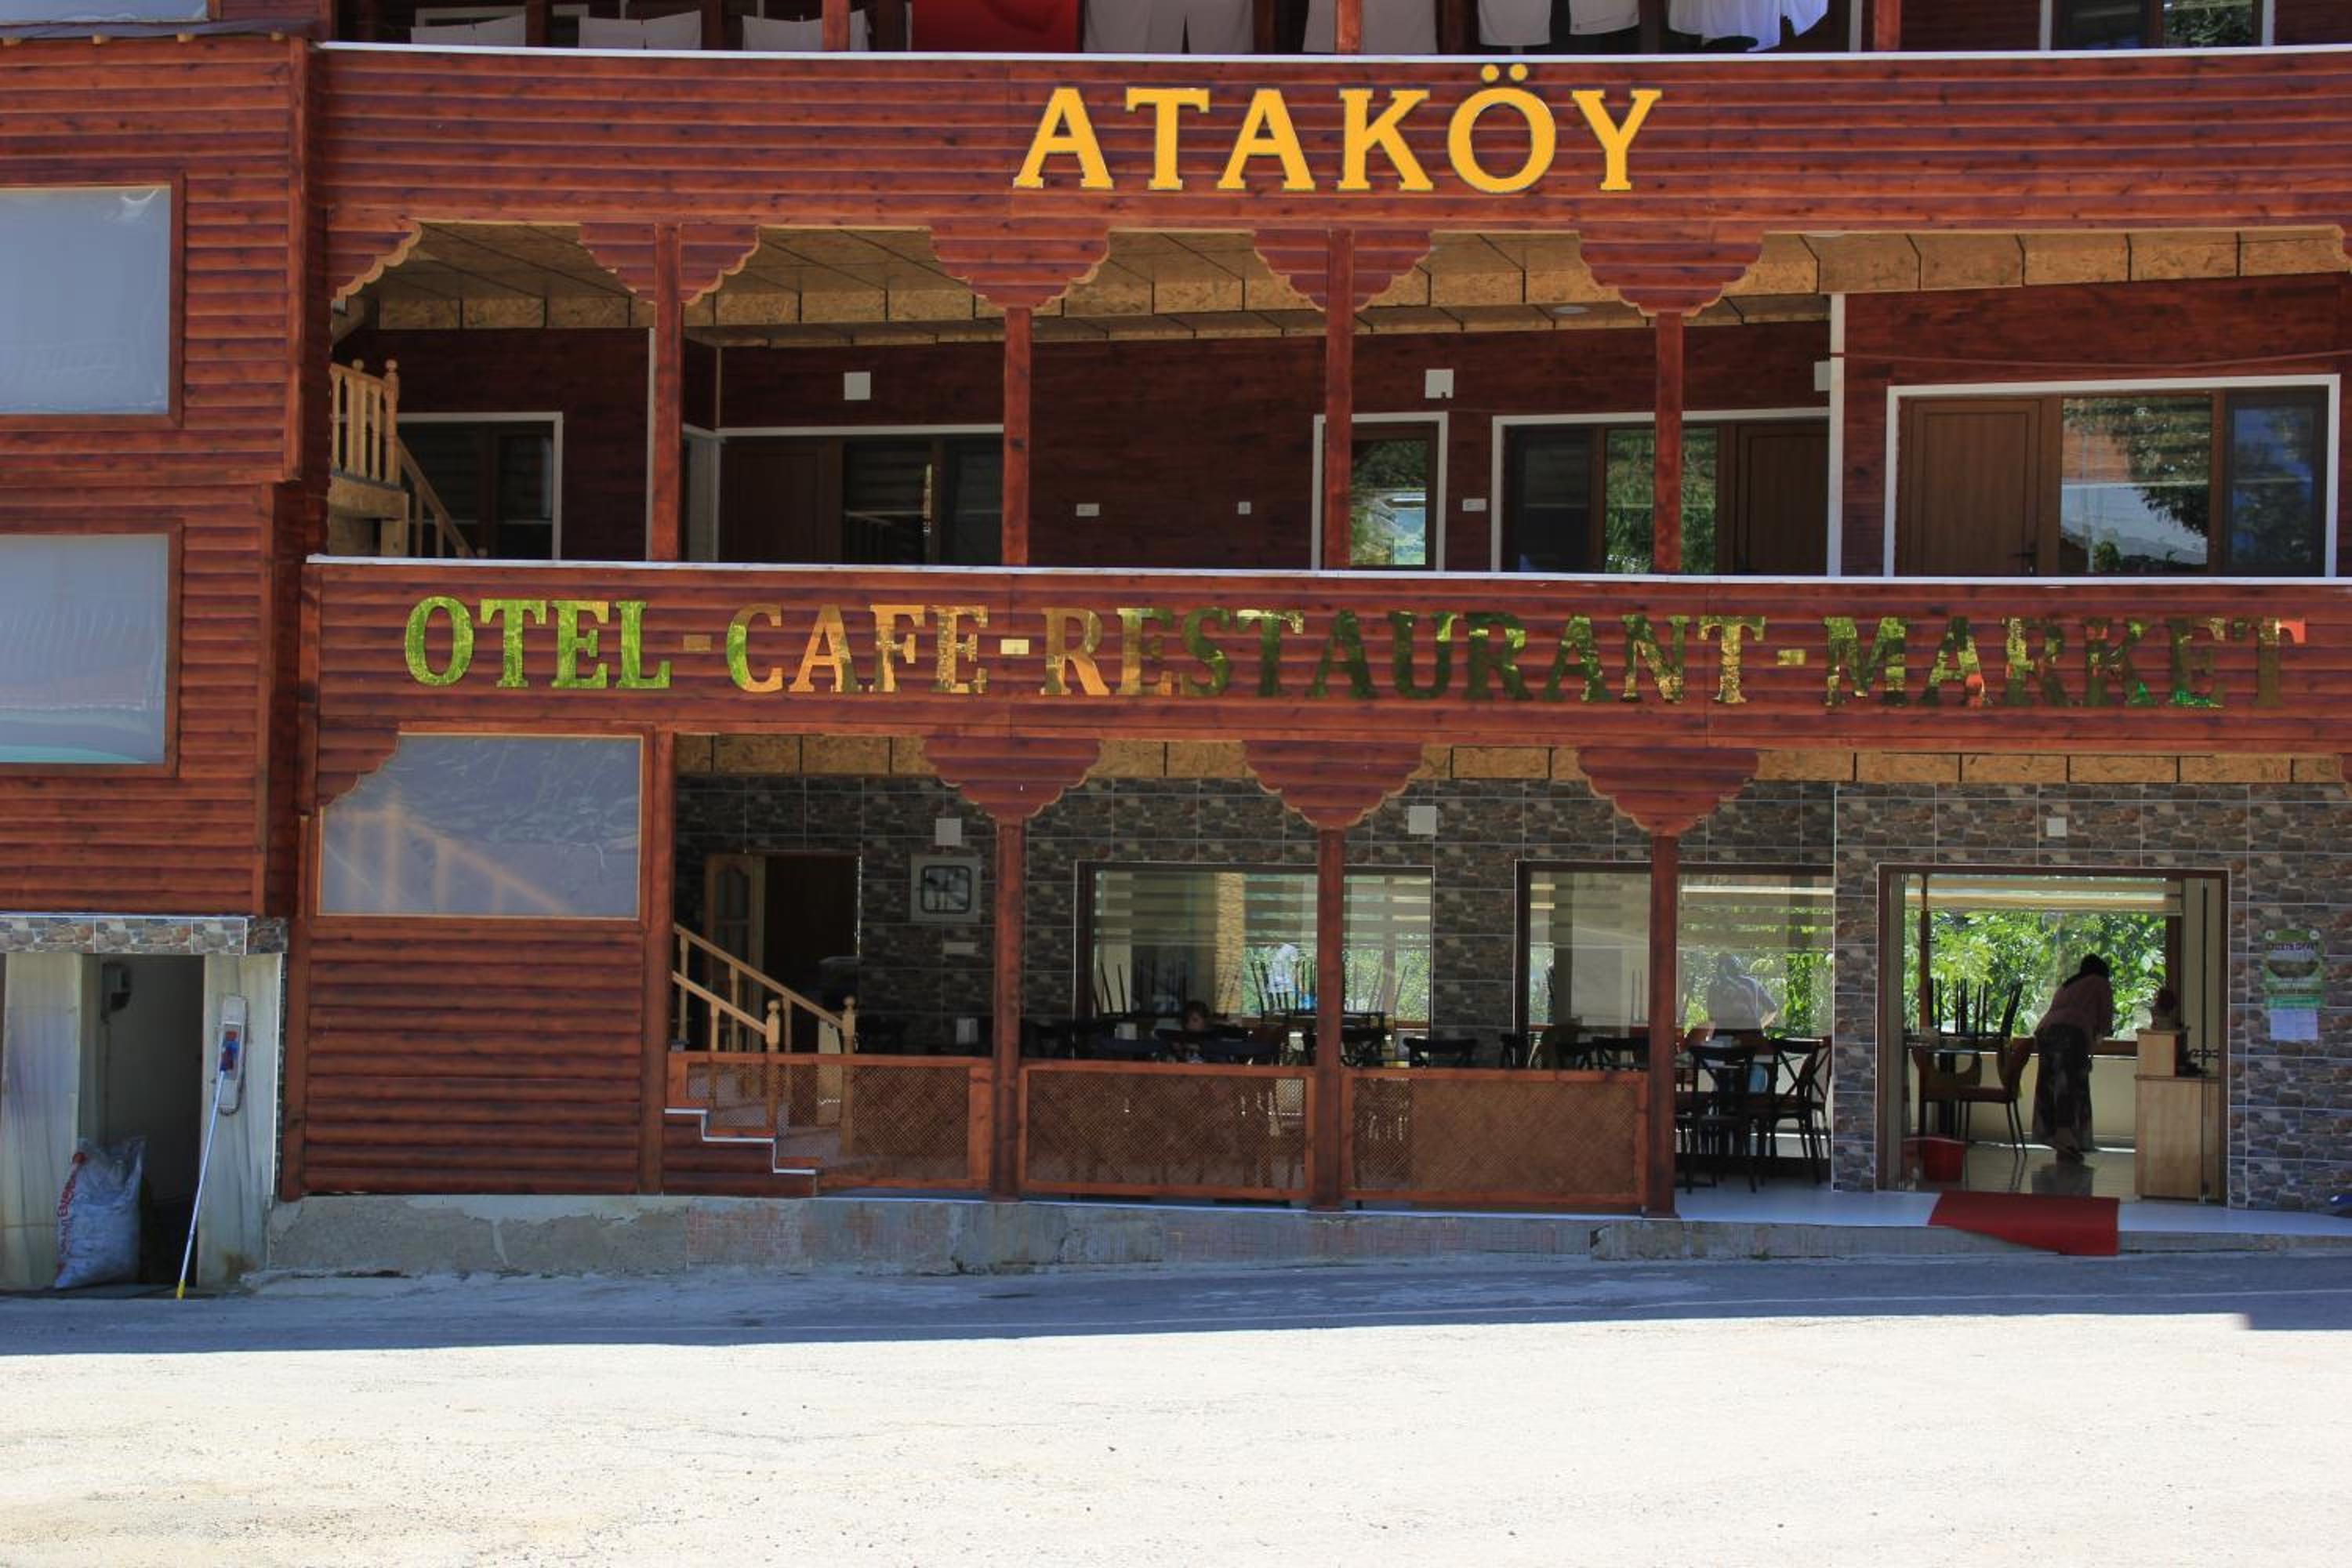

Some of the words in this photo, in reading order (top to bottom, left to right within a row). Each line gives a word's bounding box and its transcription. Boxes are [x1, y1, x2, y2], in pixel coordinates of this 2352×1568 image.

[1012, 64, 1663, 194] ATAKÖY
[405, 596, 671, 688] OTEL
[725, 604, 989, 694] CAFE
[1040, 607, 1766, 703] RESTAURANT
[1823, 615, 2307, 709] MARKET
